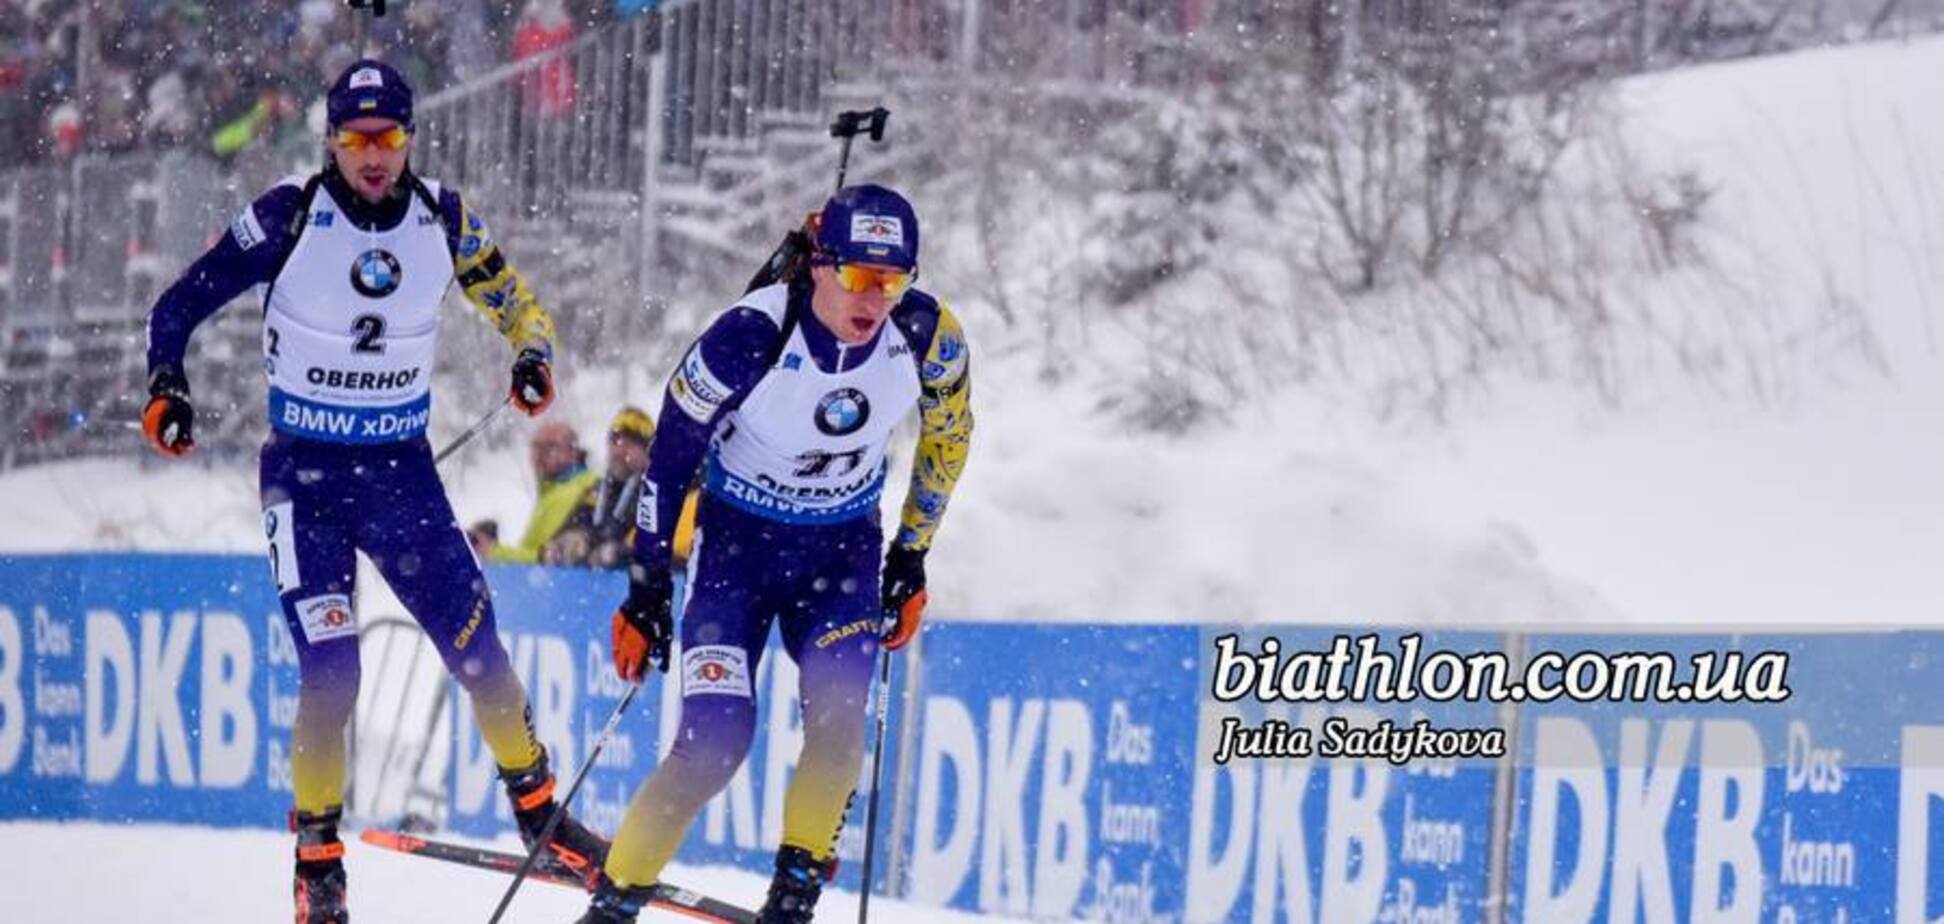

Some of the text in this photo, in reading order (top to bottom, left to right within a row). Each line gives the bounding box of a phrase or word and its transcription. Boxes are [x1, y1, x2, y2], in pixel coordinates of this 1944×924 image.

[353, 312, 386, 354] 2
[282, 401, 356, 435] BMW
[34, 605, 73, 657] Das
[267, 613, 299, 668] Da
[86, 608, 258, 788] DKB
[1107, 699, 1153, 766] Das
[1787, 719, 1843, 794] Das
[907, 697, 1092, 919] DKB
[1184, 702, 1390, 924] DKB
[1401, 793, 1464, 864] kann
[1521, 716, 1766, 924] DKB
[1780, 811, 1855, 886] kann
